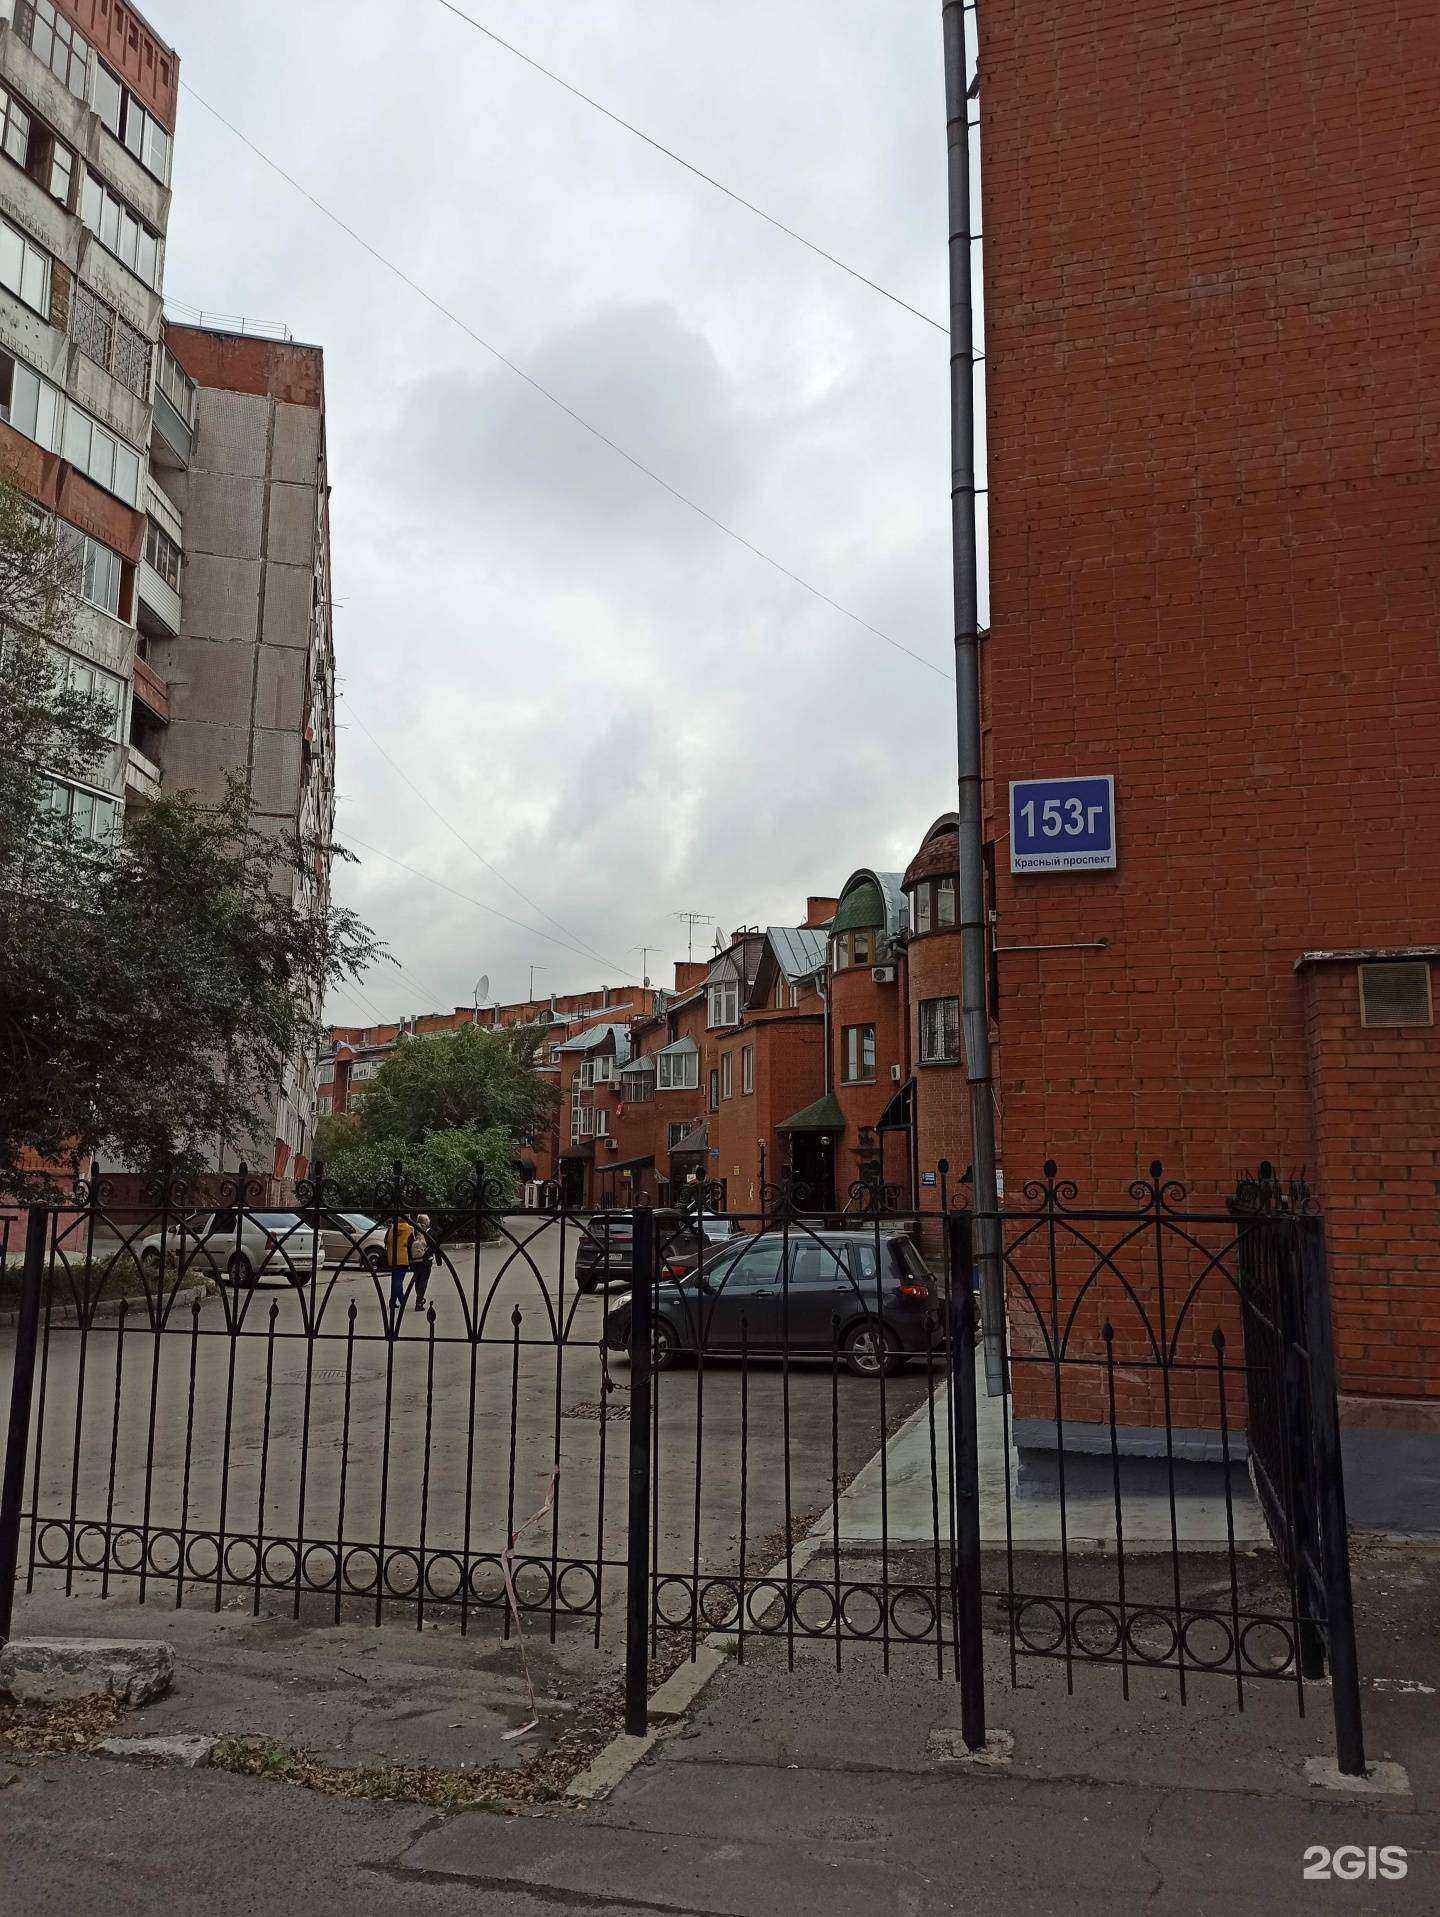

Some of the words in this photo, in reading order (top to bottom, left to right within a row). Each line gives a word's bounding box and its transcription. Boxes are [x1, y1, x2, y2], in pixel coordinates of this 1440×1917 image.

[1020, 797, 1103, 837] 153г
[1015, 856, 1060, 869] Красный
[1063, 855, 1111, 867] проспект
